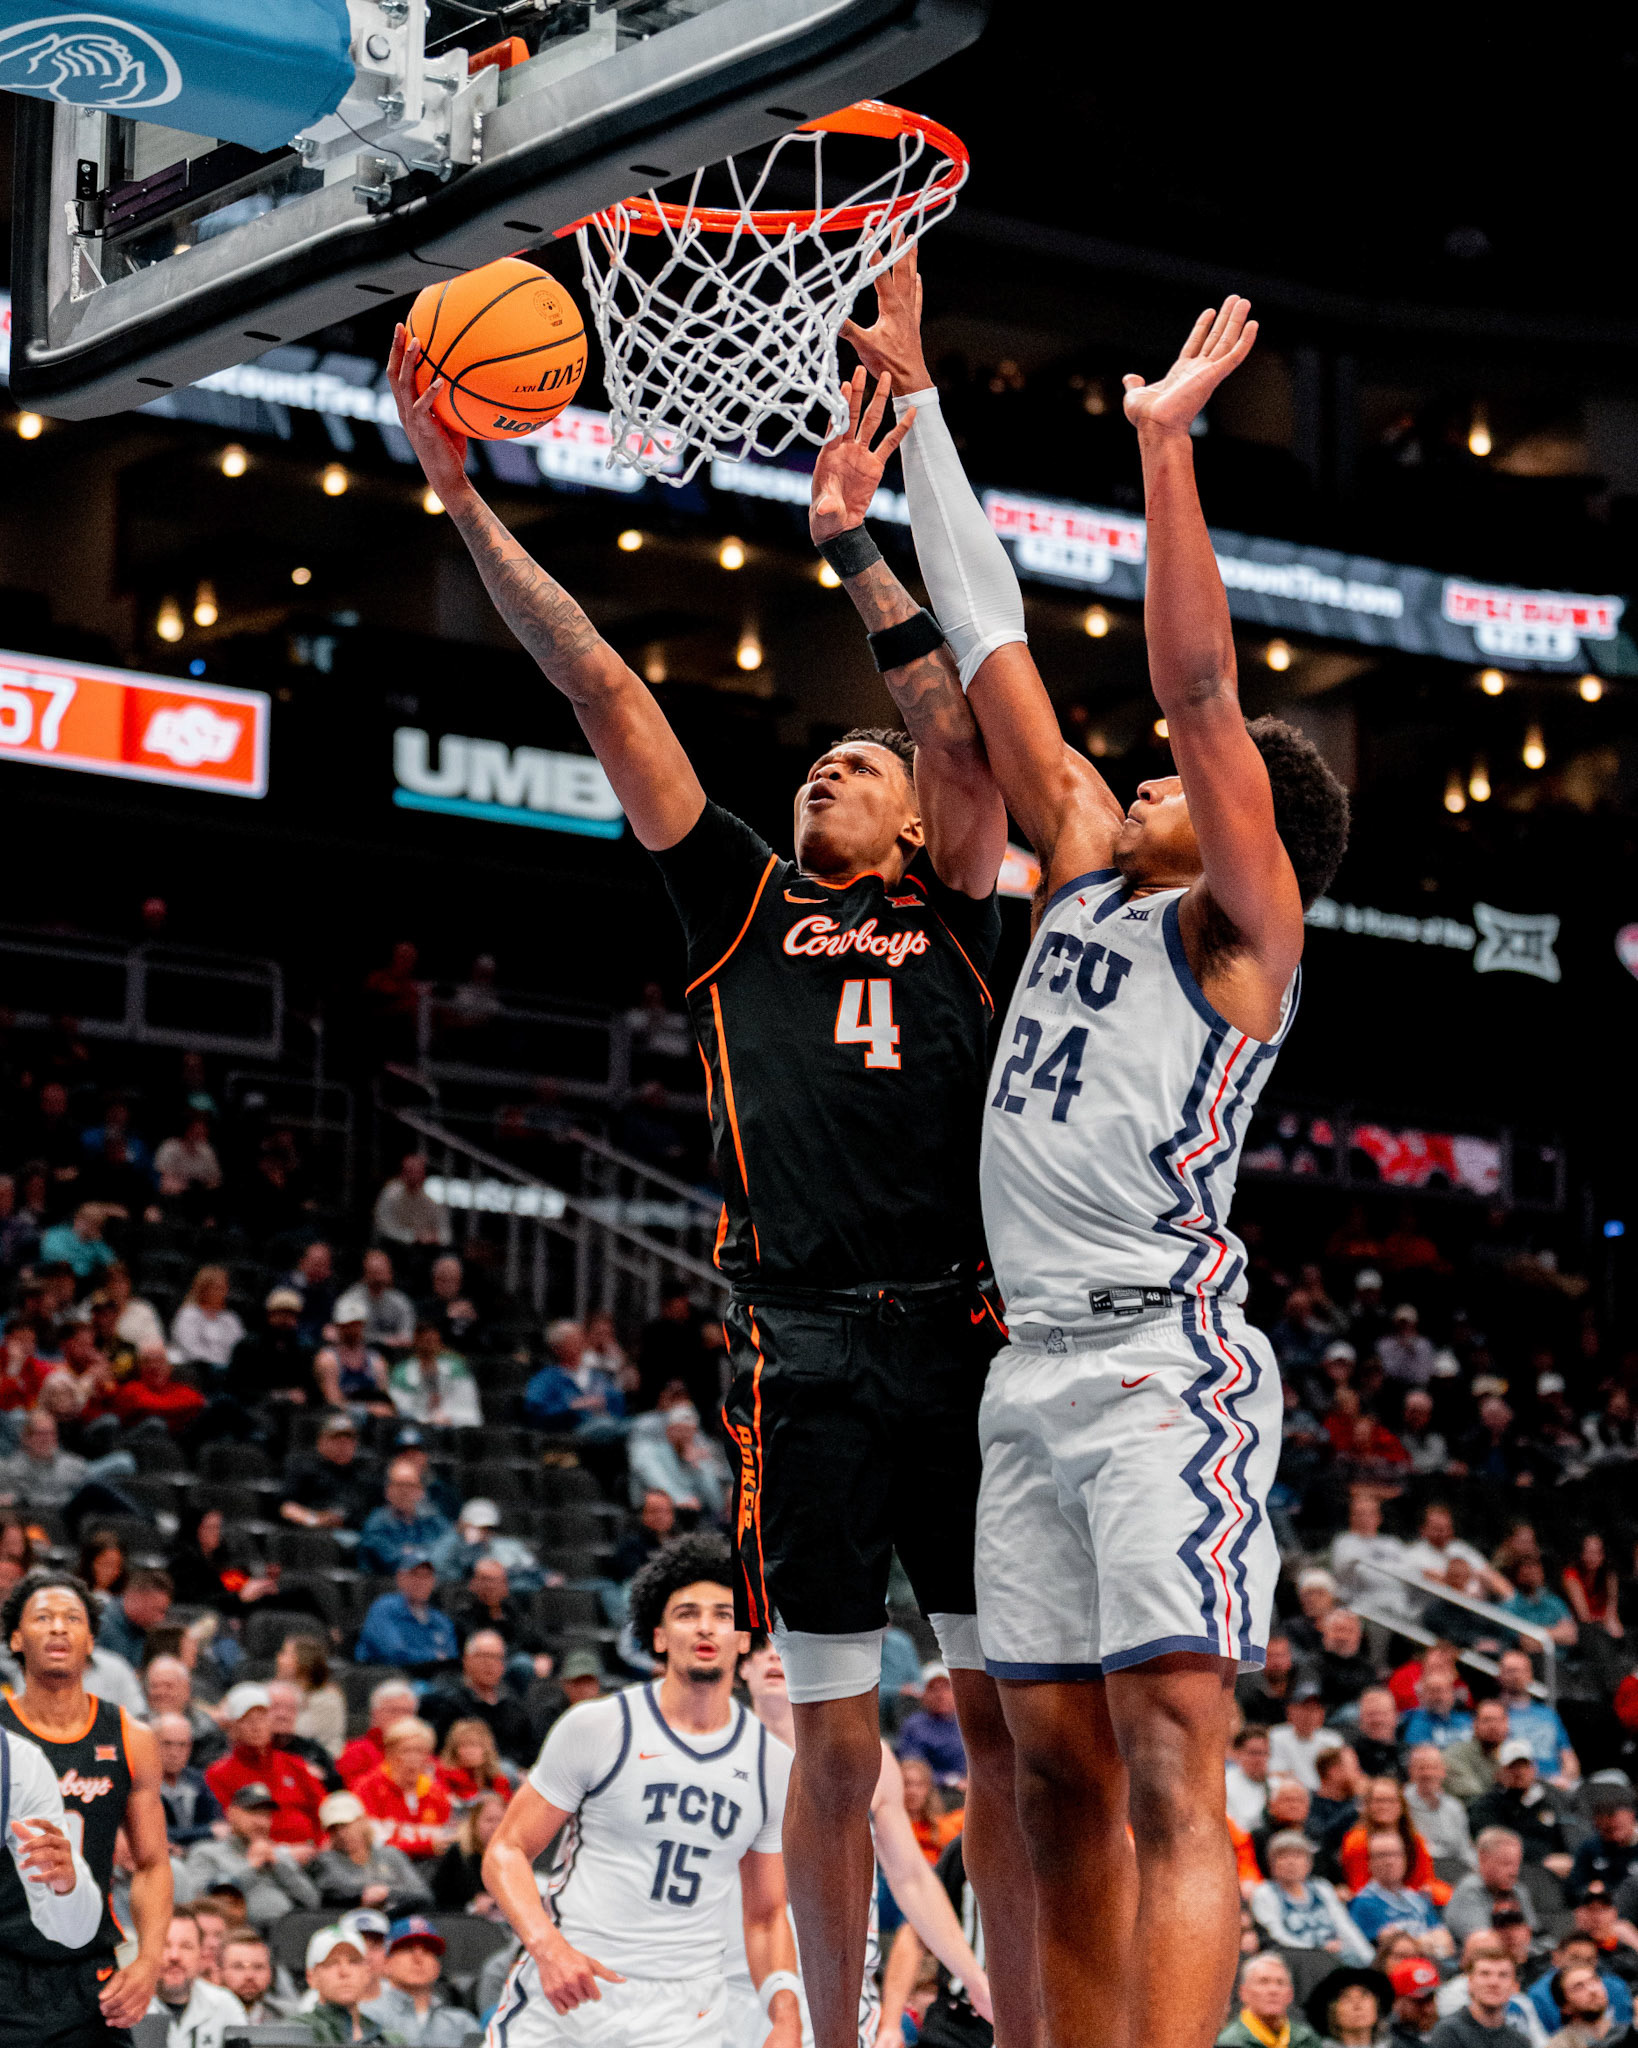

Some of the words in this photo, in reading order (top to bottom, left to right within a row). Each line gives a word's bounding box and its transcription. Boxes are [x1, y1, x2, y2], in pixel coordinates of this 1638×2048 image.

[512, 385, 536, 393] NXT
[0, 668, 77, 751] 57
[393, 726, 626, 821] UMB
[783, 914, 931, 967] Cowboys
[1027, 930, 1133, 1012] TCU
[834, 978, 901, 1070] 4
[991, 1015, 1090, 1123] 24
[1146, 1291, 1161, 1302] 48
[641, 1782, 743, 1841] TCU
[650, 1839, 713, 1909] 15
